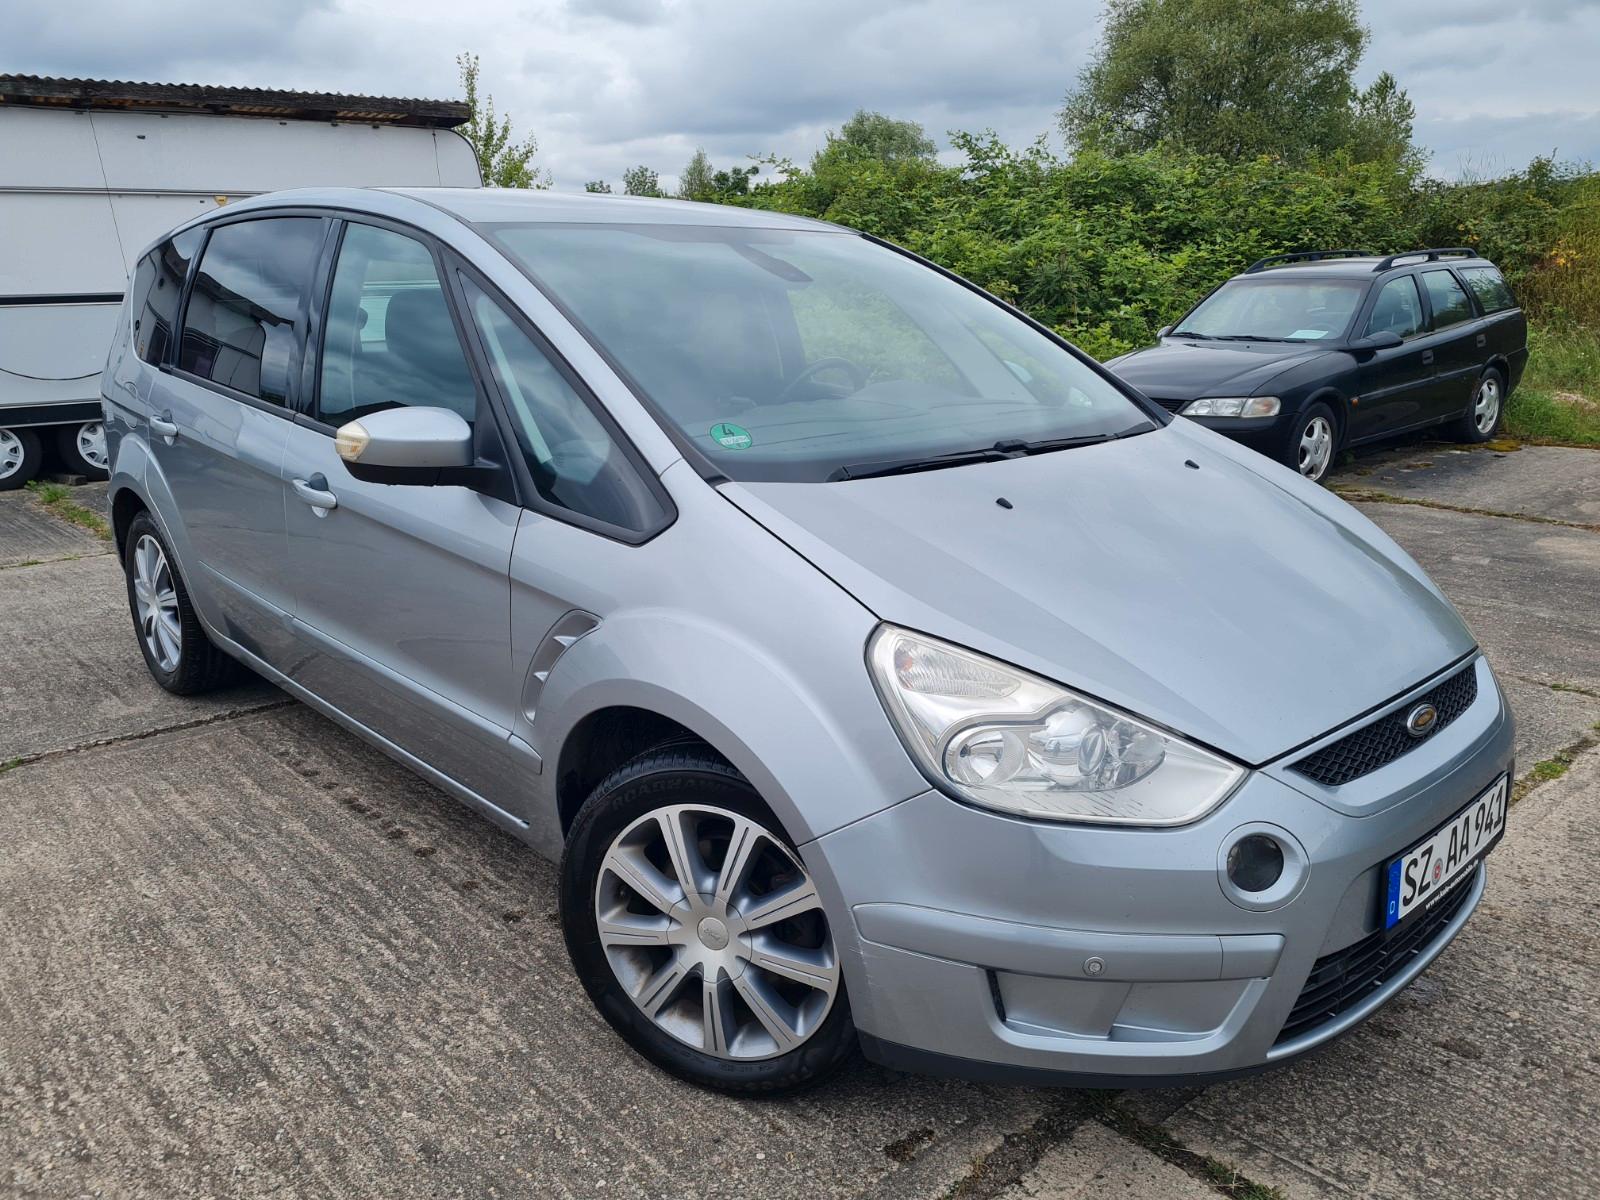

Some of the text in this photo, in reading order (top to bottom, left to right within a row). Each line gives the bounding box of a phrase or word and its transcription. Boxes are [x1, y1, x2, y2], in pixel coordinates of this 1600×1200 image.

[721, 424, 735, 437] 4
[1402, 785, 1504, 907] SZ AA 941
[1389, 900, 1396, 915] D
